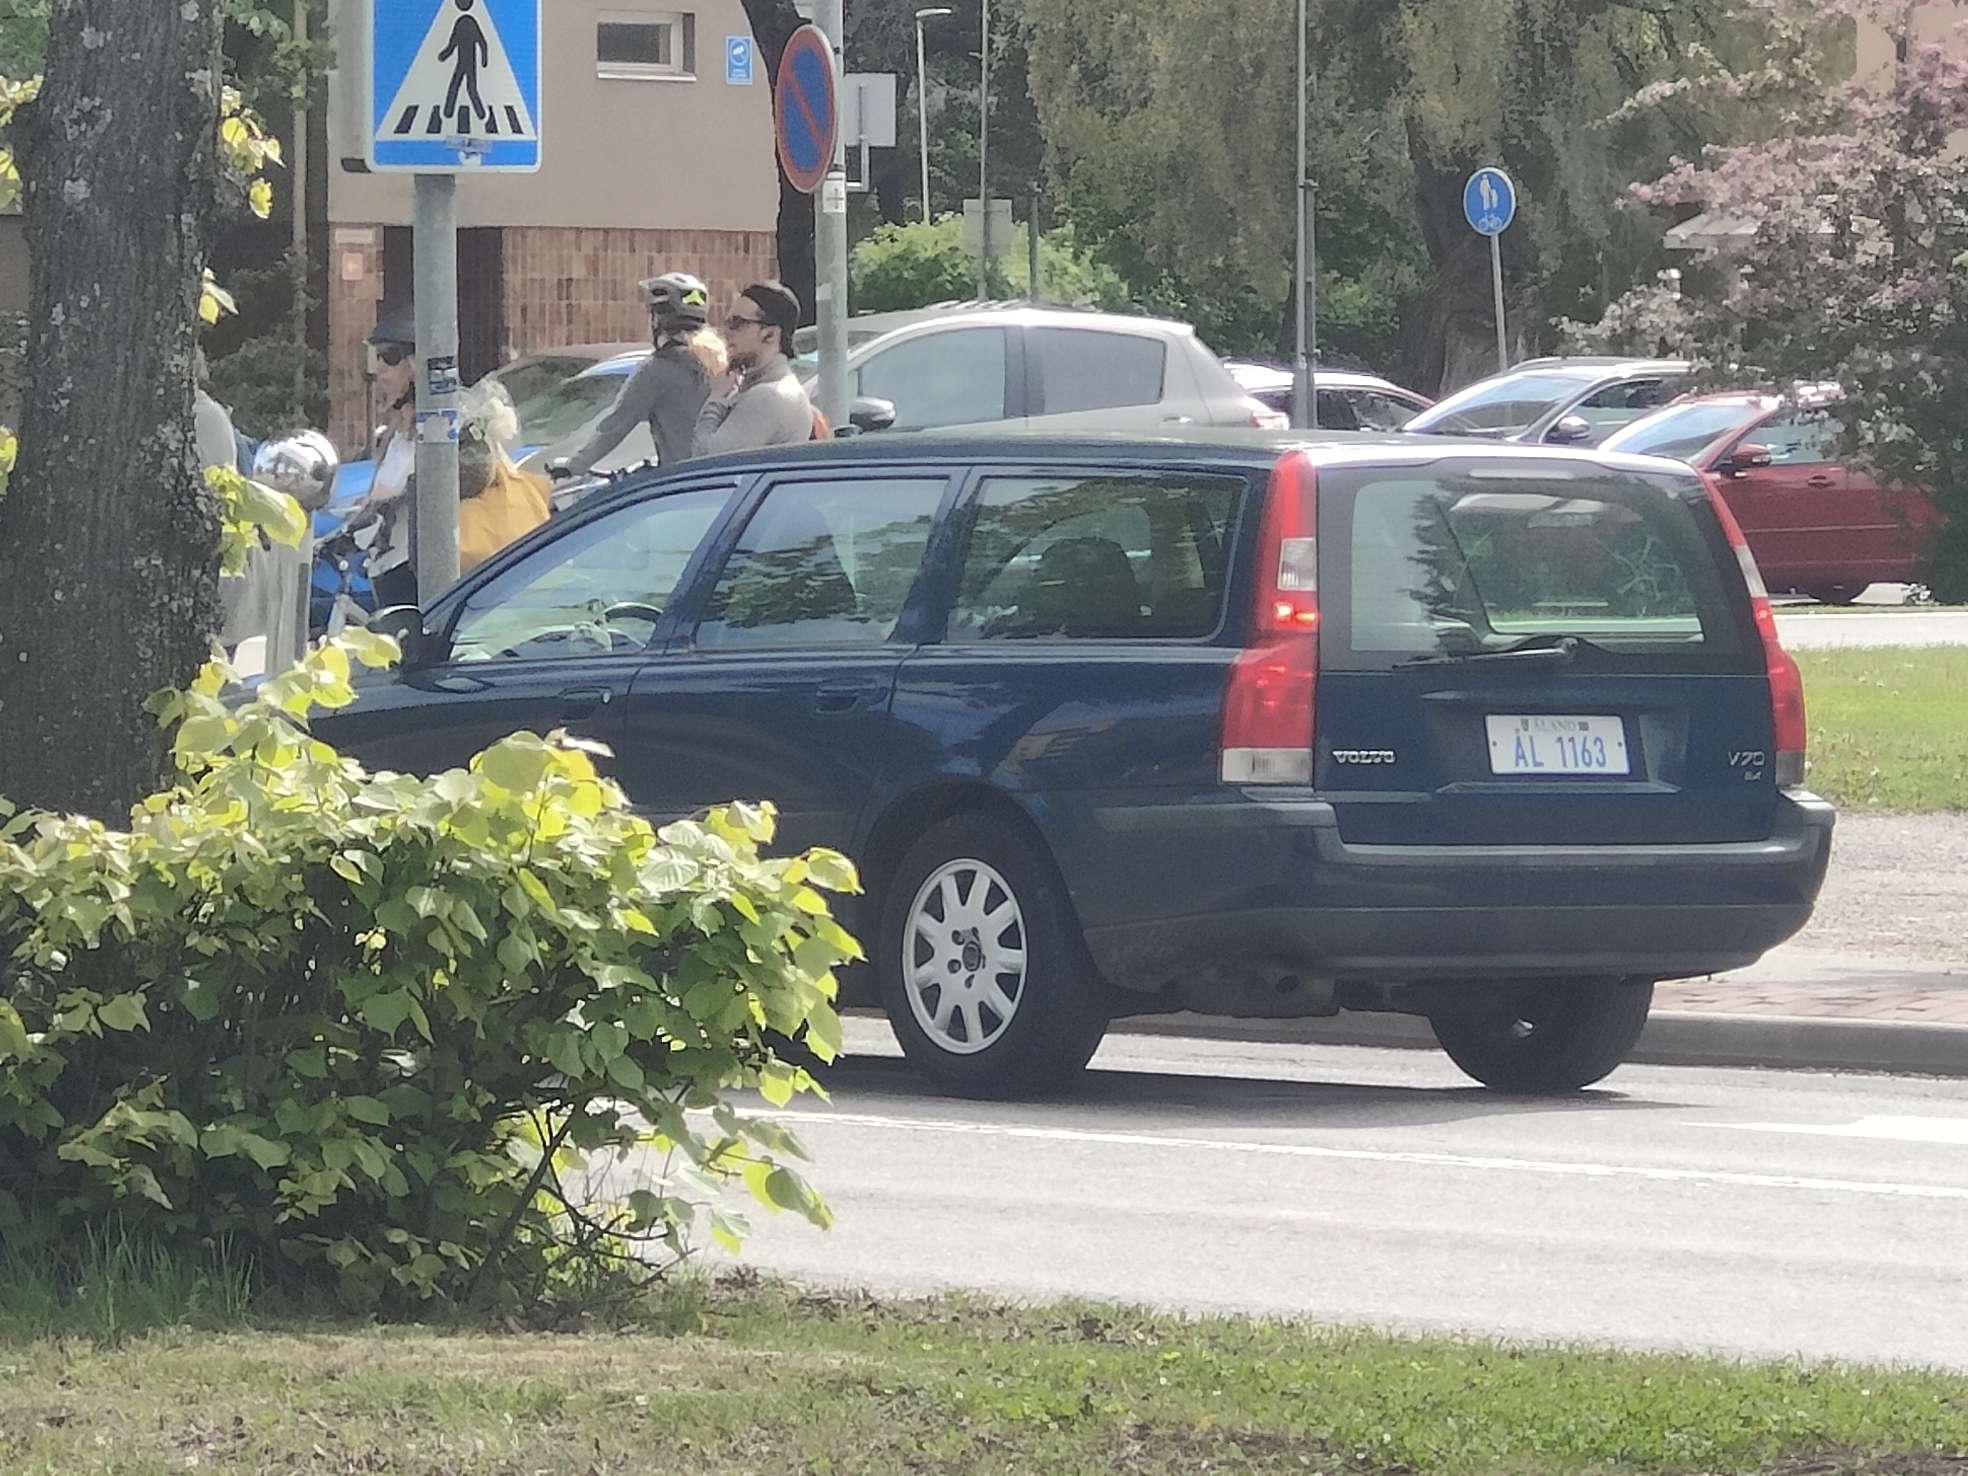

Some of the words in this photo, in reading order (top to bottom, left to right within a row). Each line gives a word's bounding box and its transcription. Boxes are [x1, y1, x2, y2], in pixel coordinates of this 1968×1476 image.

[1332, 750, 1395, 763] VOLVO
[1556, 736, 1606, 768] 1163
[1728, 751, 1765, 766] V70
